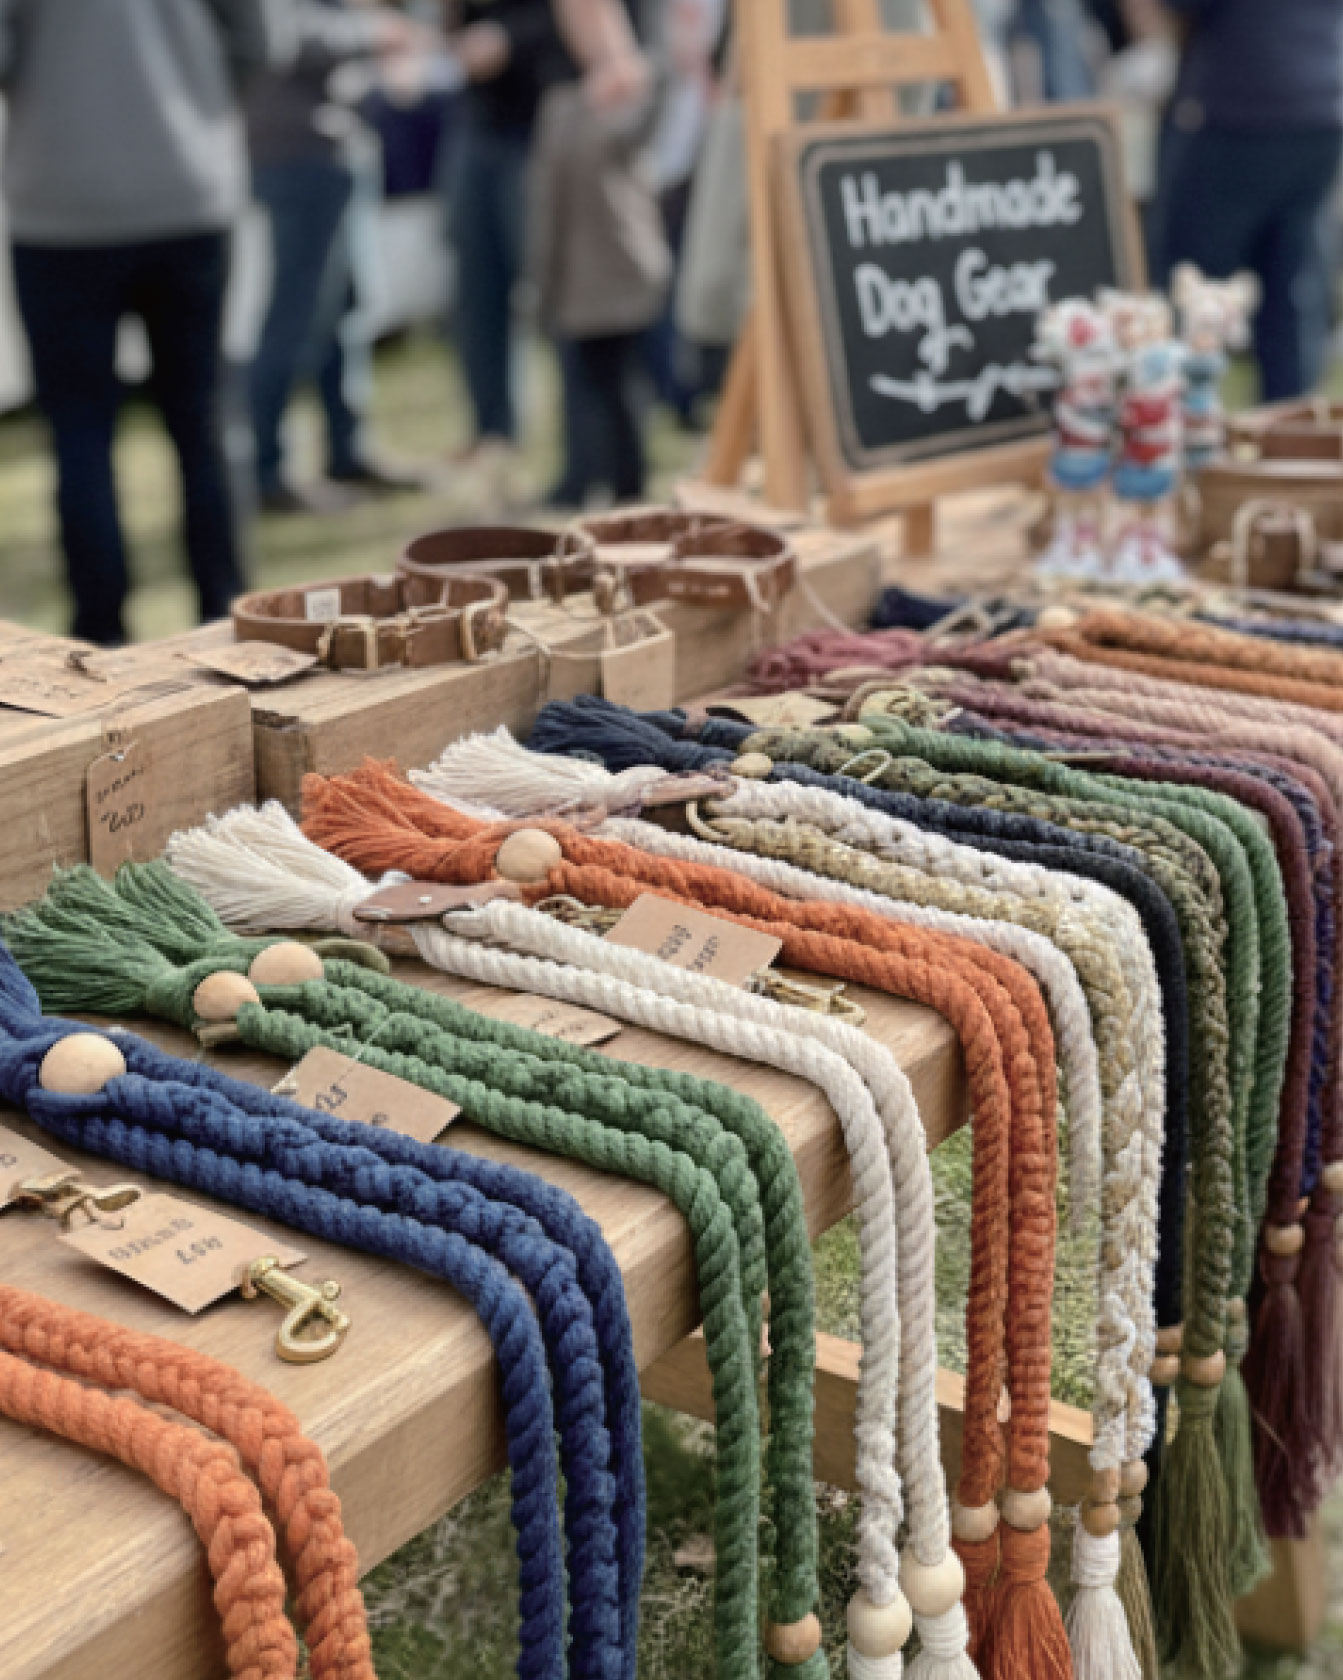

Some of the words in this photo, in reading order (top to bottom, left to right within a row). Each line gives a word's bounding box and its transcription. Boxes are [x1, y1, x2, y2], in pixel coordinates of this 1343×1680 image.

[840, 150, 1083, 248] Handmade
[853, 262, 966, 376] Dog
[953, 247, 1056, 320] Gear
